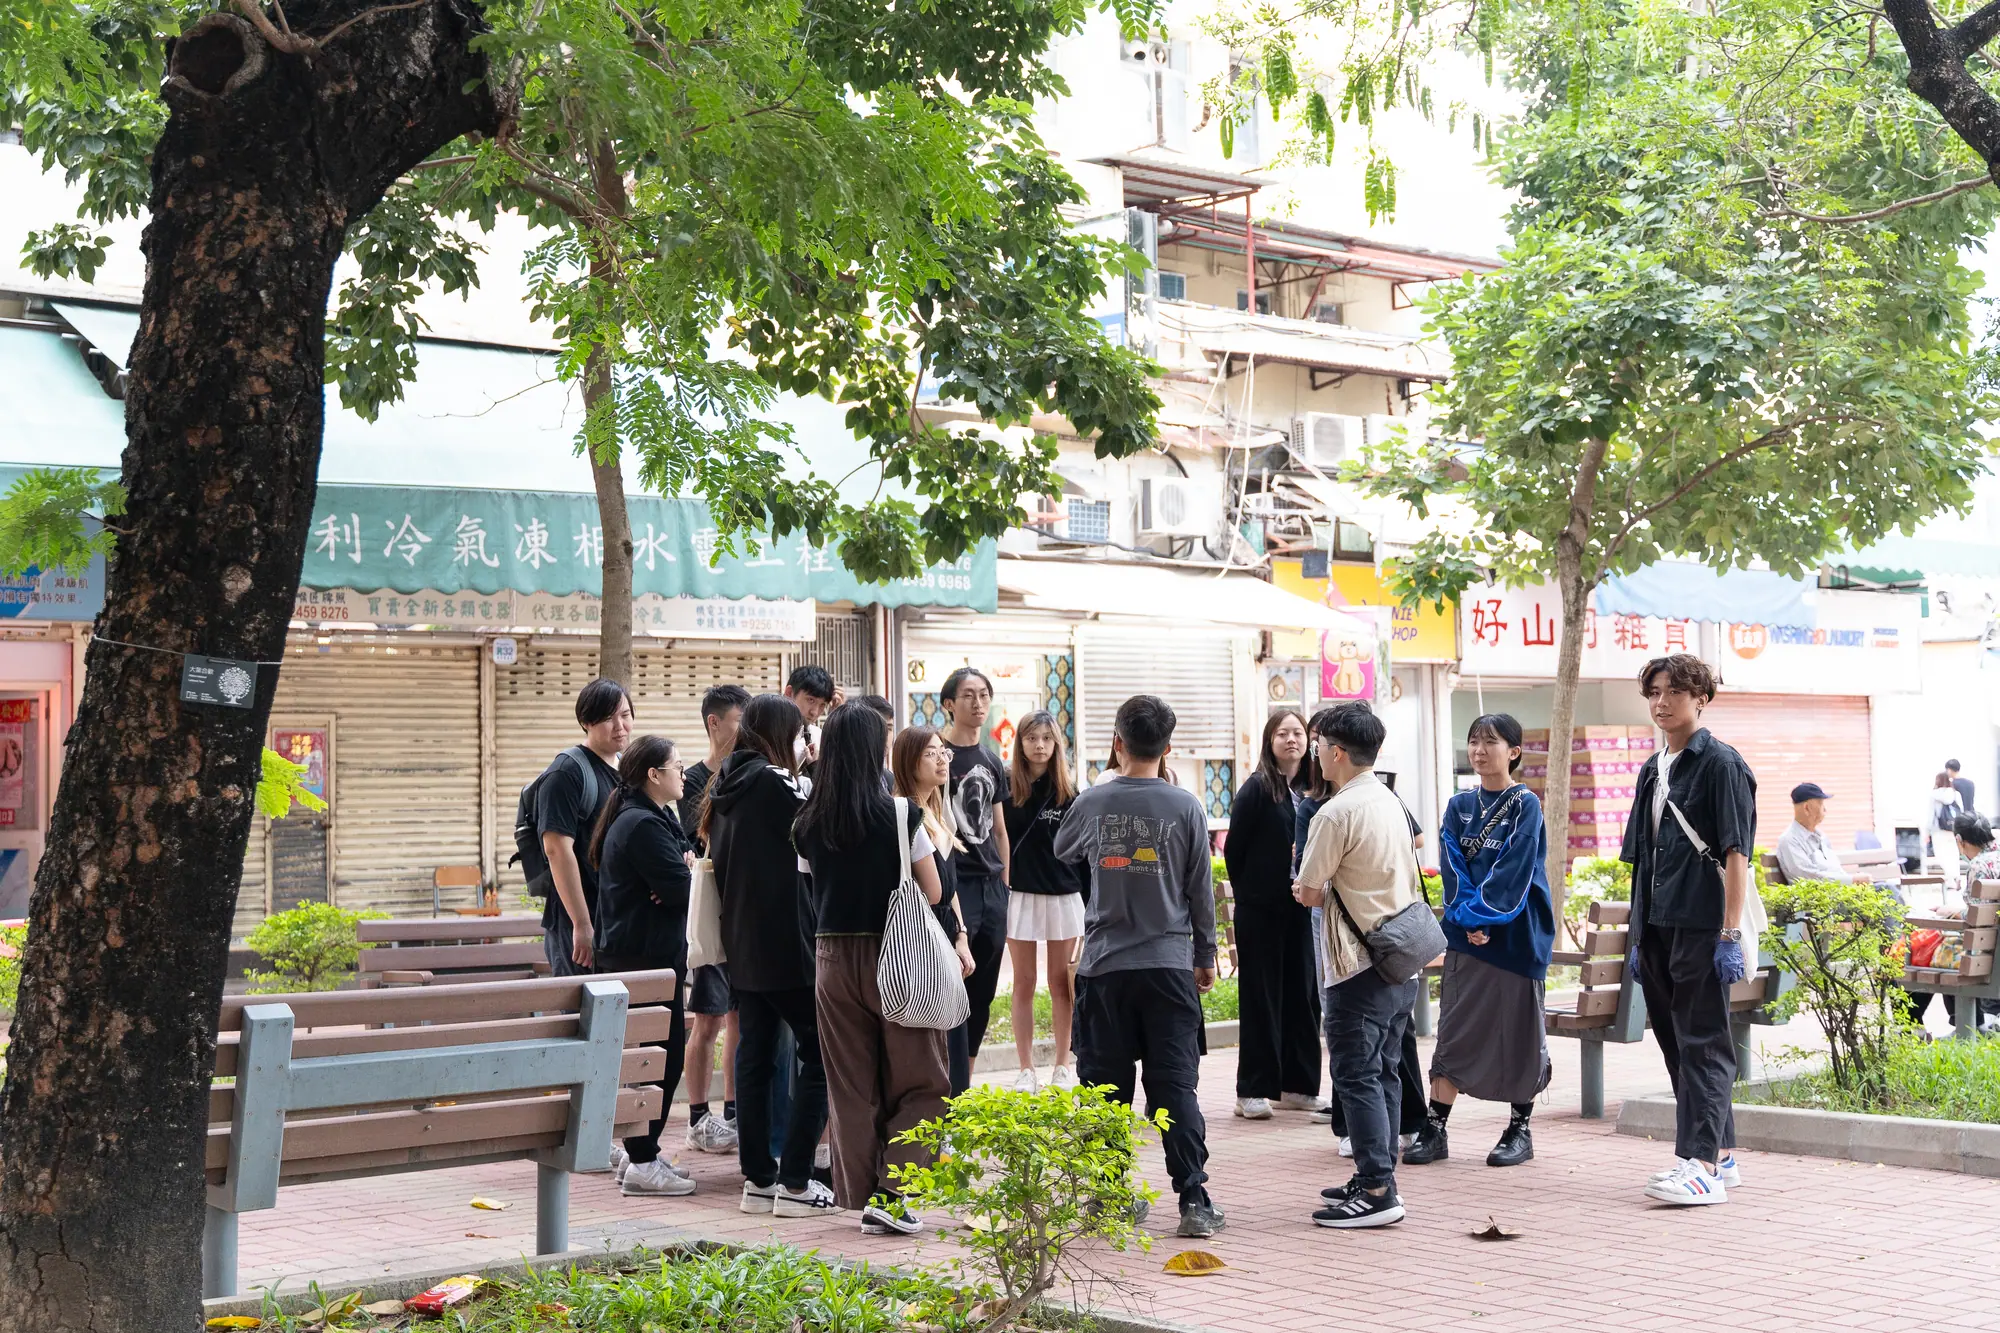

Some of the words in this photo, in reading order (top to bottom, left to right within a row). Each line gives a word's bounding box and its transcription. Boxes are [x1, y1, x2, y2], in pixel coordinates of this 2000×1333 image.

[938, 575, 972, 592] 6968
[320, 606, 349, 620] 8276
[749, 618, 772, 630] 9256
[1391, 626, 1418, 641] HOP
